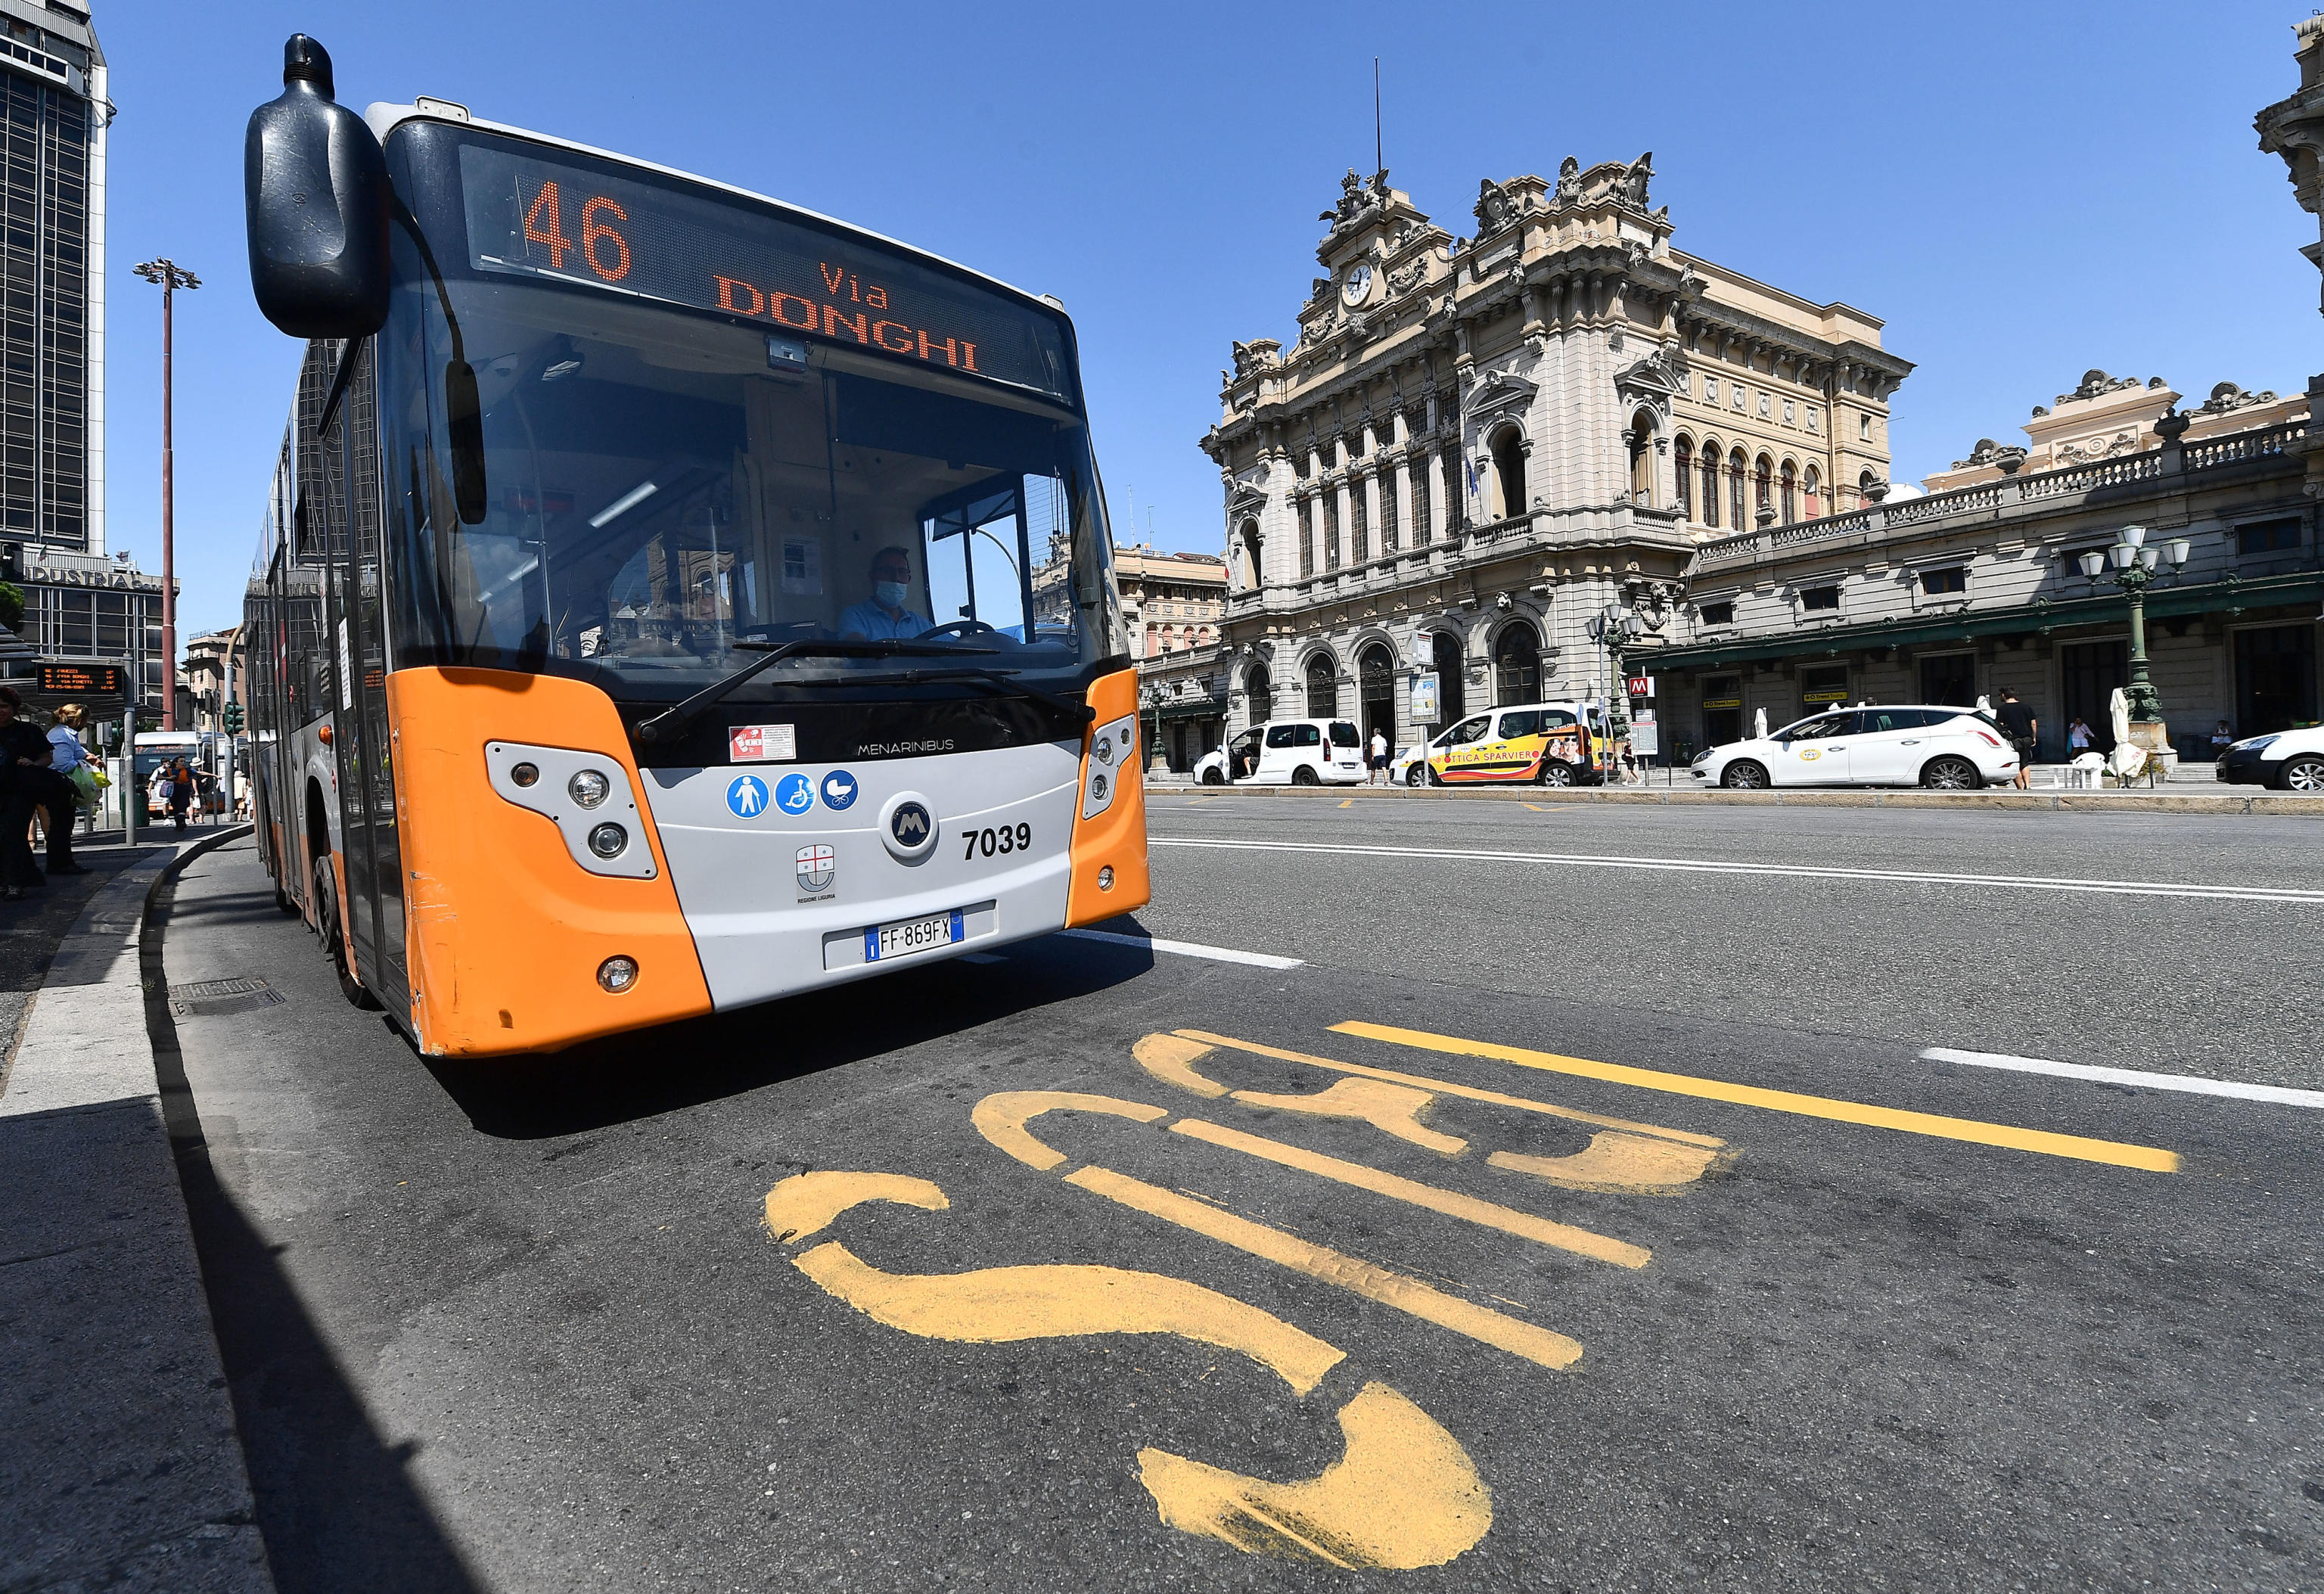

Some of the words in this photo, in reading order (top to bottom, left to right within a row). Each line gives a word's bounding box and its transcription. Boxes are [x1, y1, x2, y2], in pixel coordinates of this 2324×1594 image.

[523, 179, 633, 283] 46
[819, 260, 889, 311] Via
[712, 273, 980, 374] DONGHI
[1631, 679, 1647, 692] M
[857, 738, 955, 757] MENARINIBUS
[962, 821, 1032, 862] 7039
[797, 896, 817, 904] REGIONE
